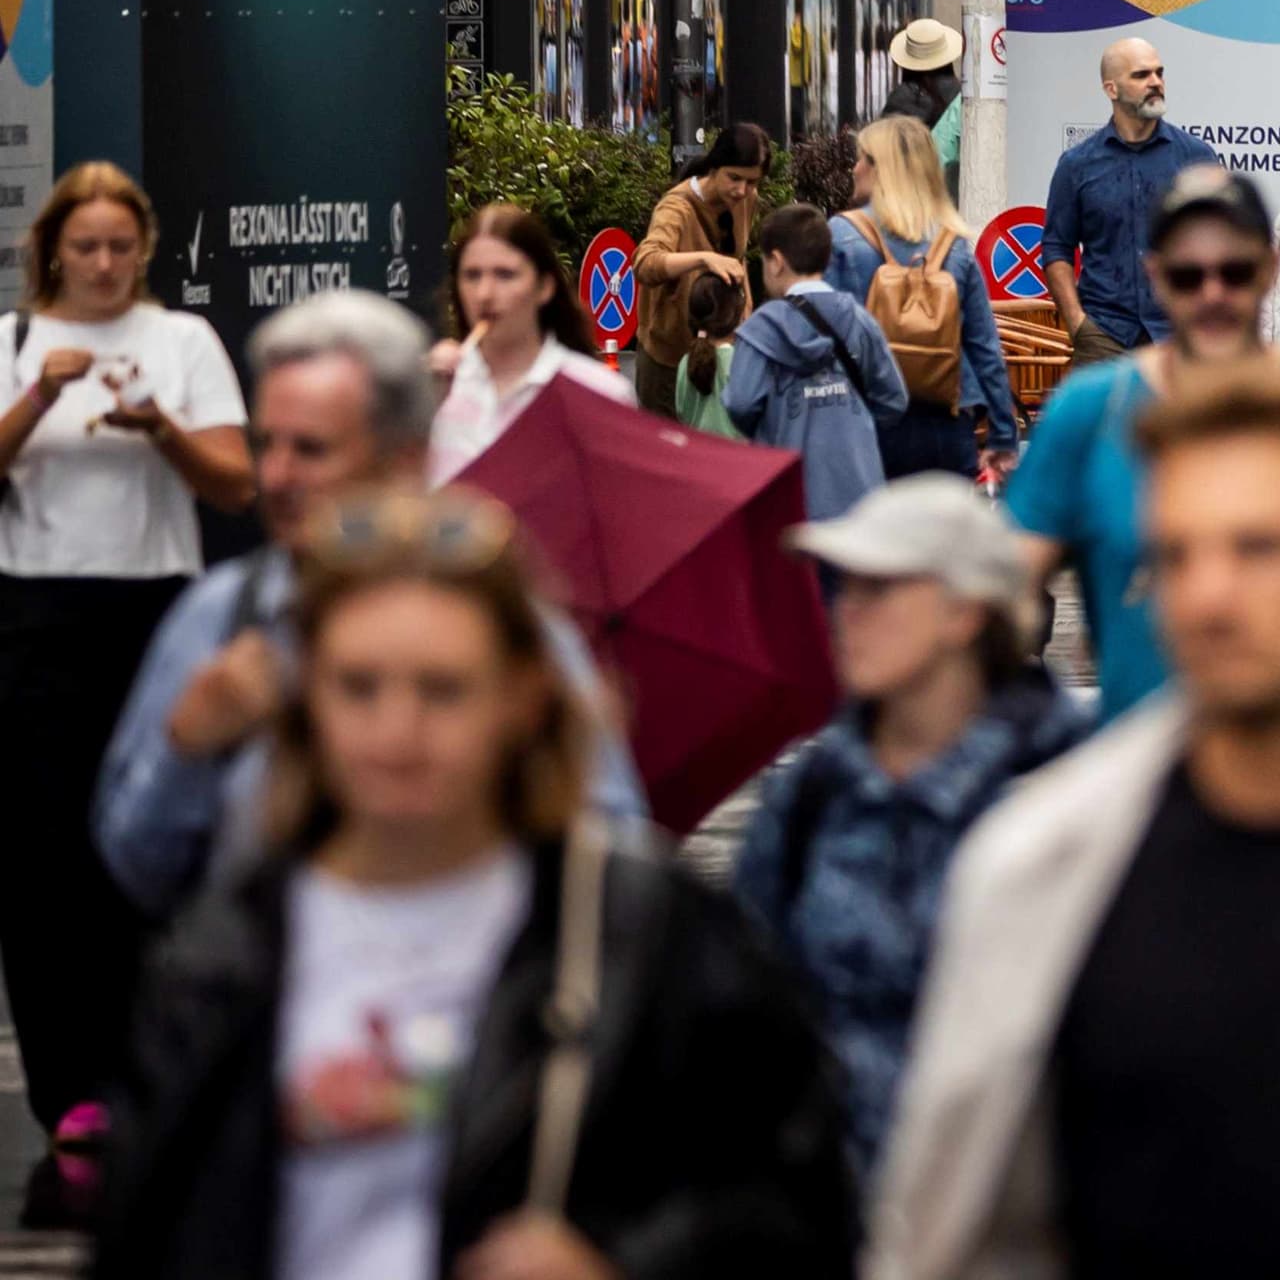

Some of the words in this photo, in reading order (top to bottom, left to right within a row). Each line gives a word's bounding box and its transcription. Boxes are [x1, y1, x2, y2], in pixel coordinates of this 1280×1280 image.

[229, 204, 289, 247] REXONA
[291, 195, 333, 245] LÄSST
[334, 201, 368, 243] DICH
[249, 264, 291, 306] NICHT
